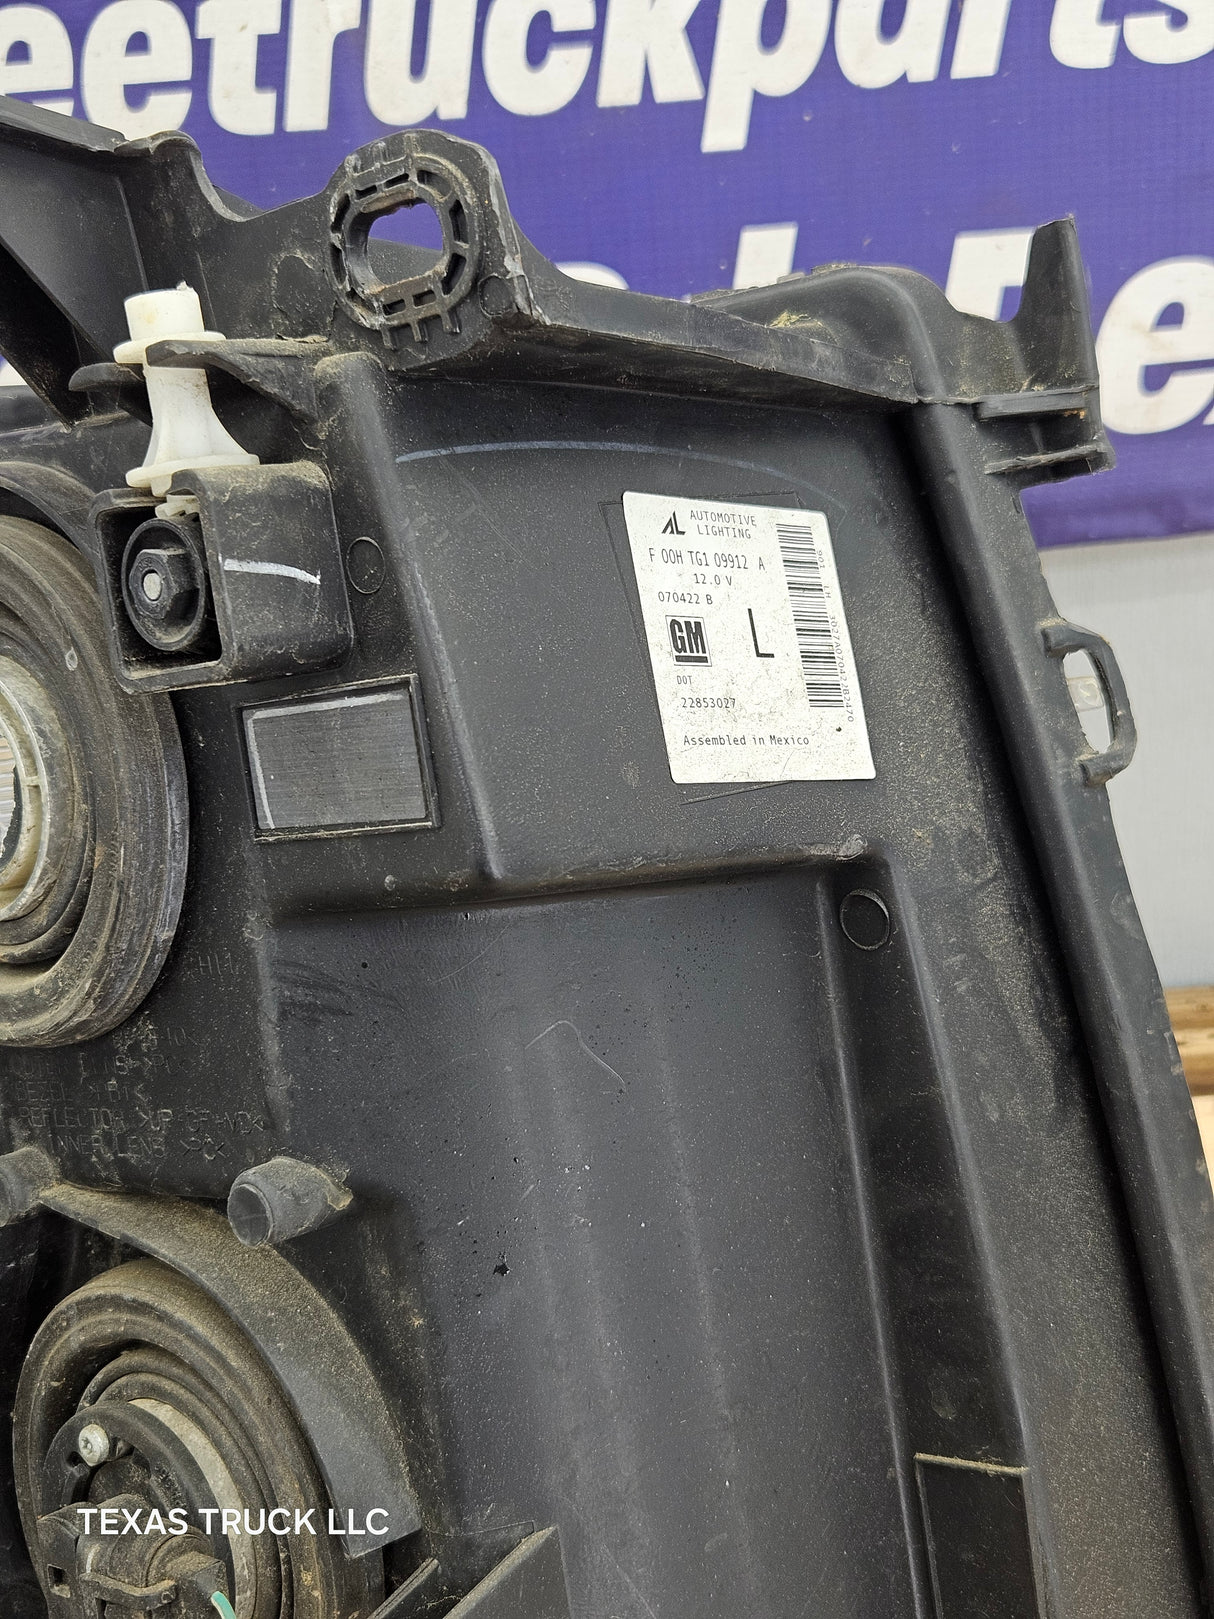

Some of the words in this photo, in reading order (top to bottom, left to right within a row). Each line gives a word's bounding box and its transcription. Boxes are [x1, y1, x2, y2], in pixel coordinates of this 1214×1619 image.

[690, 510, 757, 527] AUTOMOTIVE
[697, 524, 751, 539] LIGHTING
[648, 547, 655, 562] F
[687, 550, 709, 566] TG1
[714, 552, 748, 569] 09912
[758, 556, 765, 571] A
[694, 573, 721, 585] 12.0
[725, 575, 732, 586] V
[816, 550, 826, 569] 901
[823, 584, 832, 599] LH
[658, 591, 700, 604] 070422
[705, 594, 713, 605] B
[669, 618, 707, 655] GM
[747, 608, 775, 658] L
[676, 675, 693, 685] DOT
[681, 697, 736, 709] 22853027
[683, 734, 747, 746] Assembled
[752, 735, 765, 745] in
[769, 734, 810, 746] Mexico
